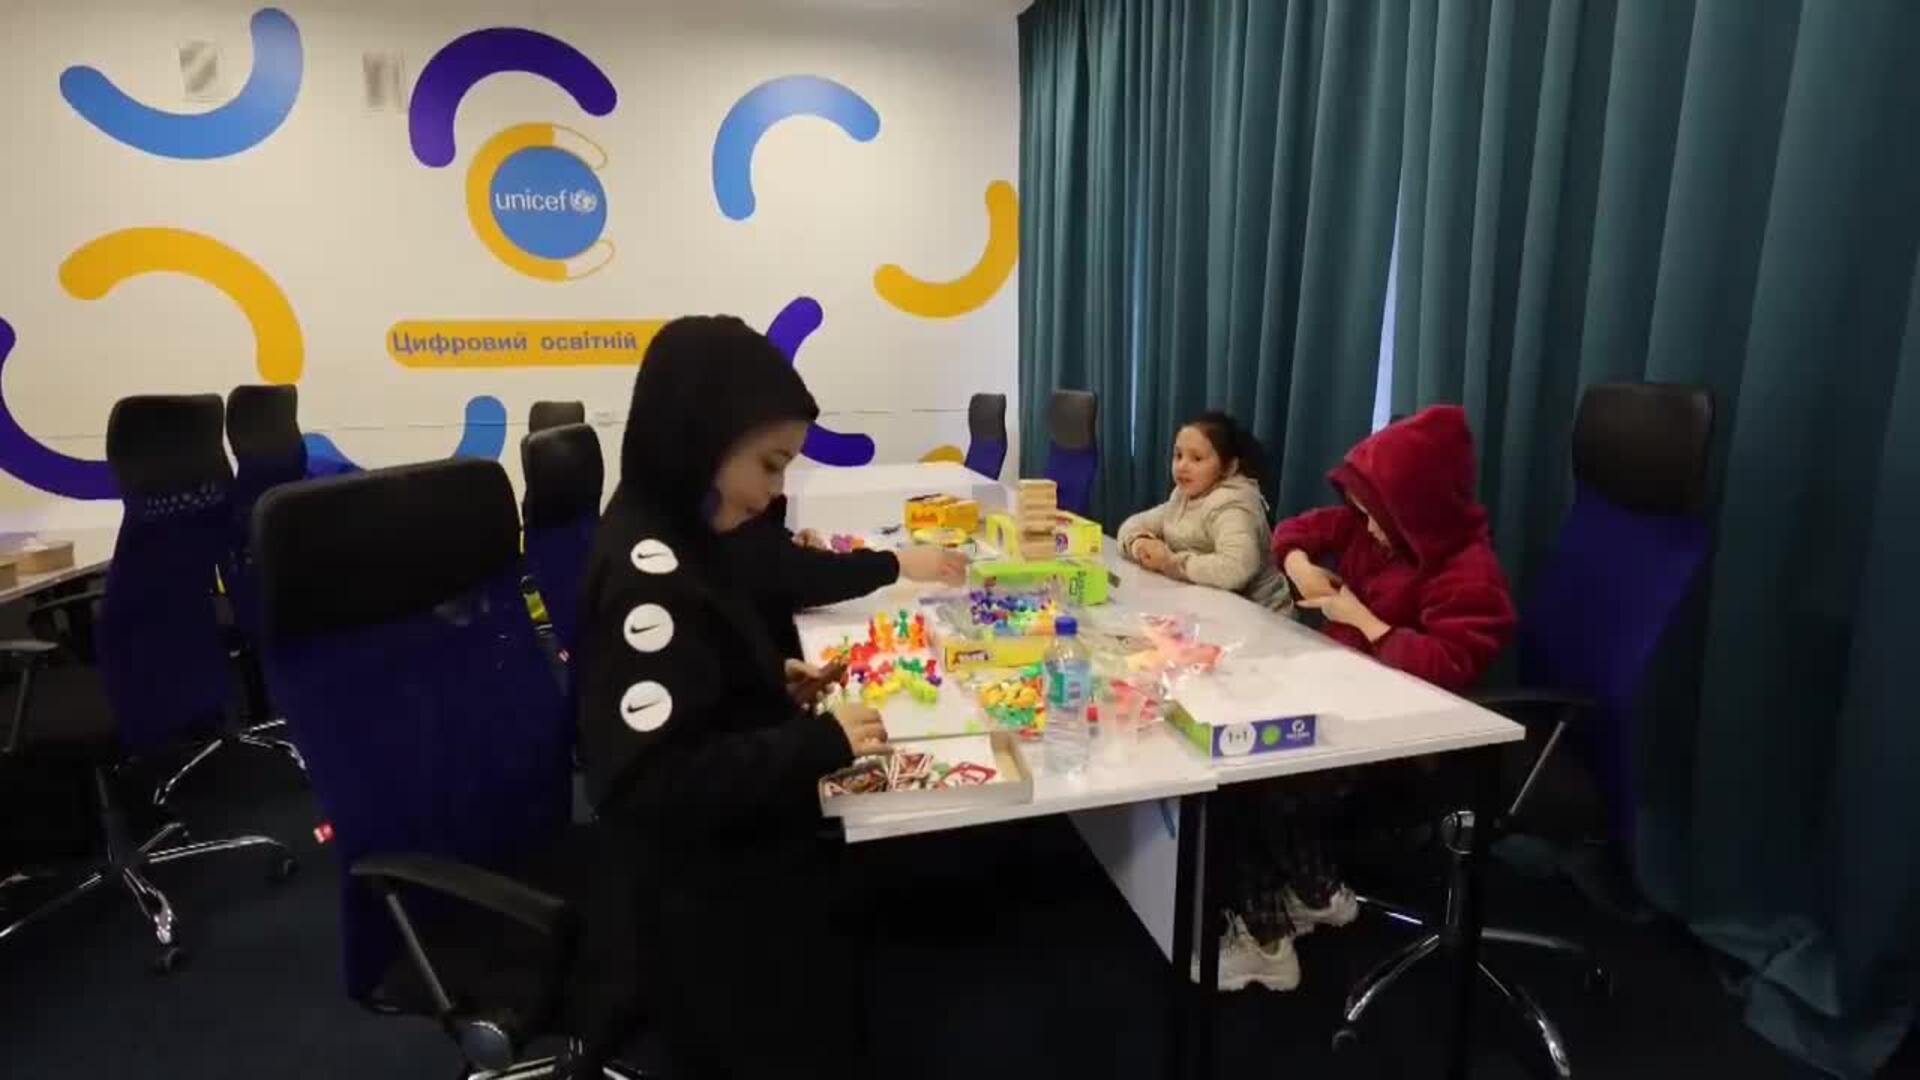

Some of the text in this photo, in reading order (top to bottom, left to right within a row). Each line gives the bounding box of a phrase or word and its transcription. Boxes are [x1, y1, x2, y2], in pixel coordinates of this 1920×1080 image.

[495, 187, 568, 212] unicef
[393, 330, 637, 355] Цифровий освітній
